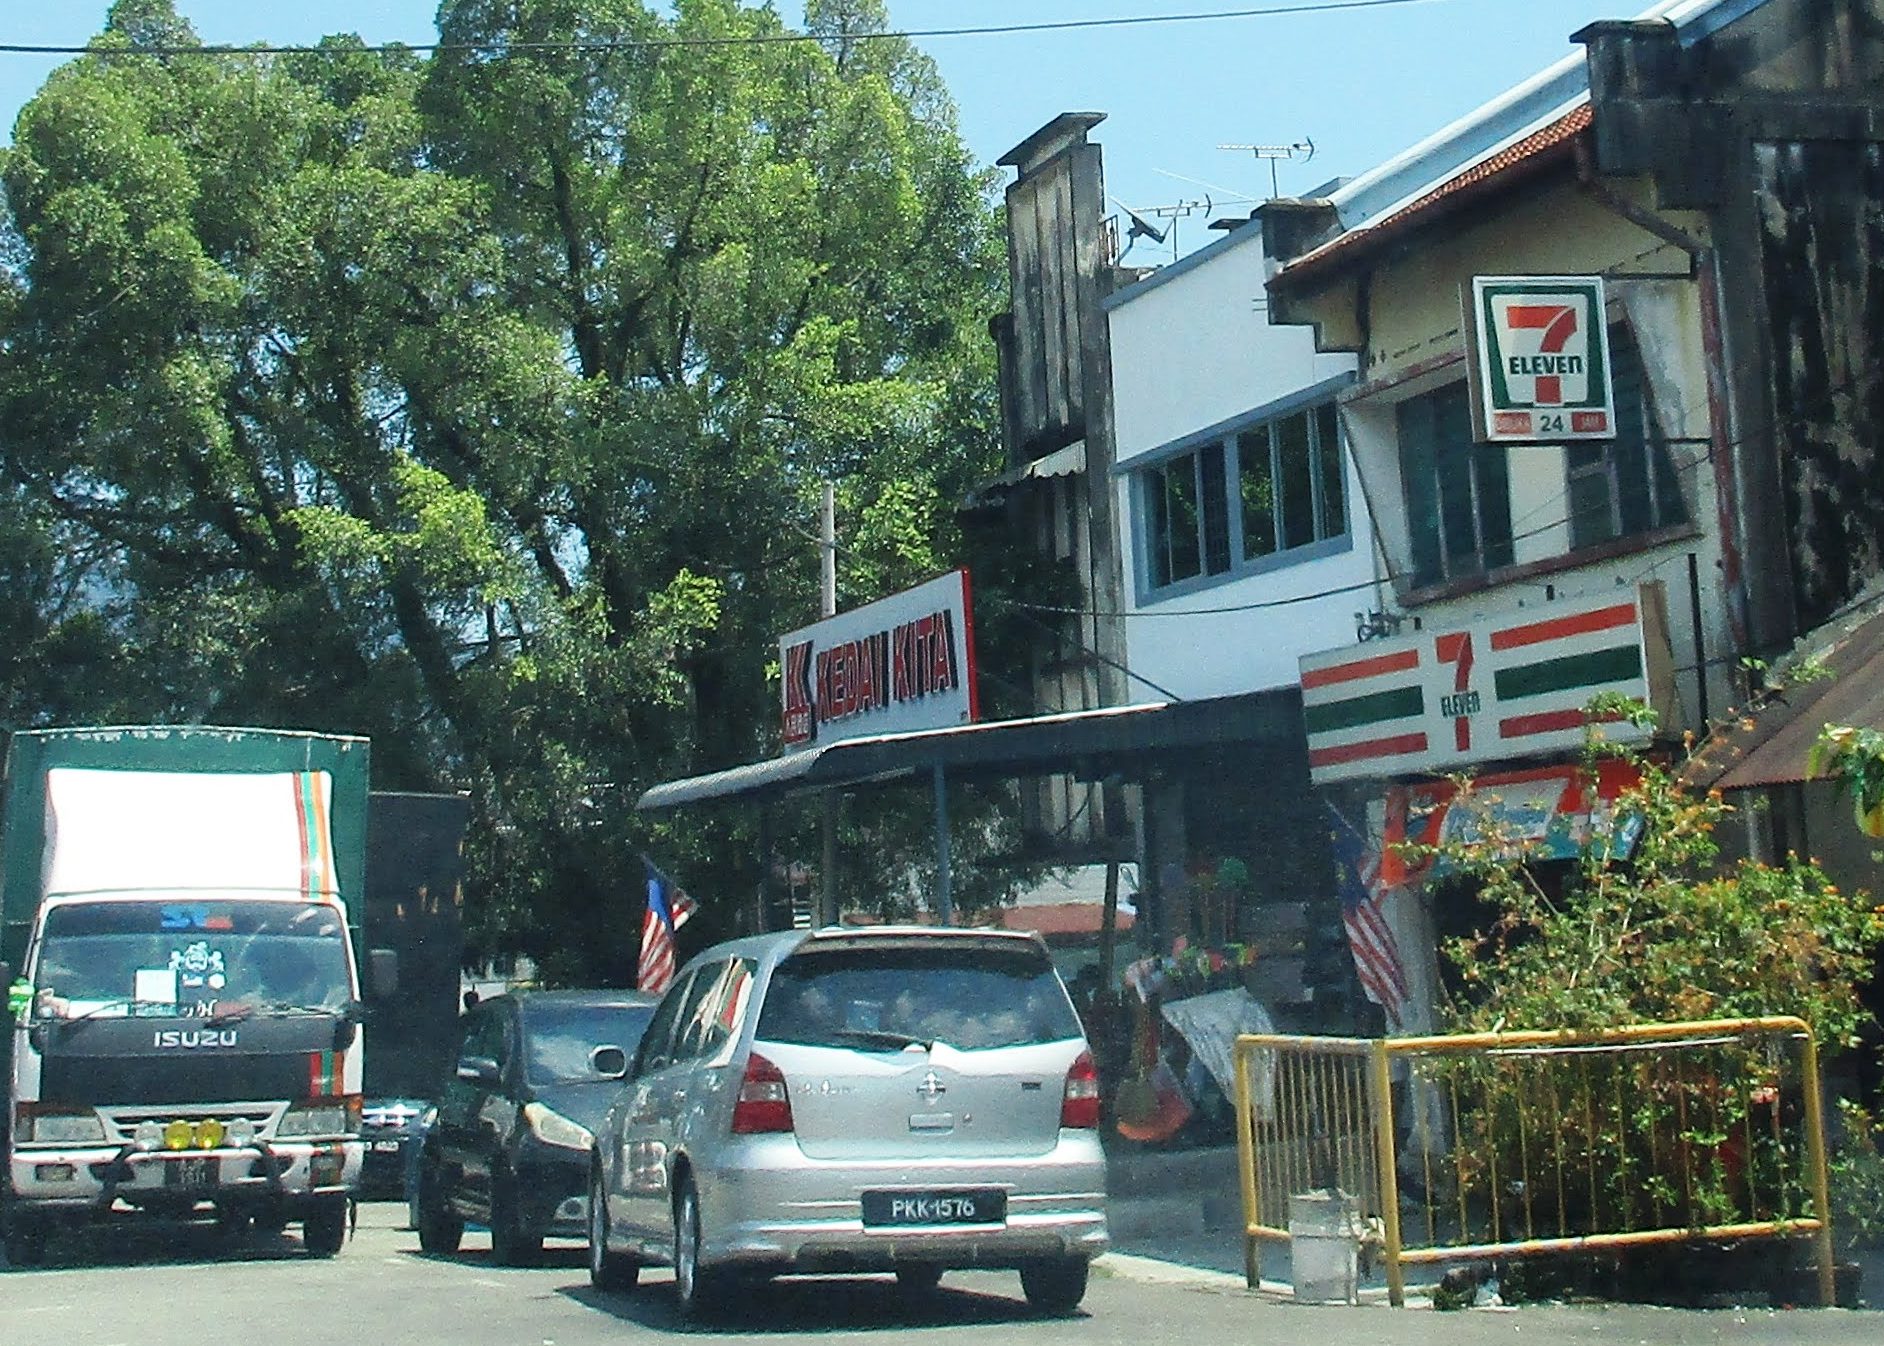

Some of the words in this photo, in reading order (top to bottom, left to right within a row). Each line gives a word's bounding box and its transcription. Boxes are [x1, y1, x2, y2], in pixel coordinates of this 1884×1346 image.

[1540, 415, 1564, 431] 24
[817, 631, 889, 723] KEDAI
[893, 609, 959, 702] KITA
[154, 1031, 237, 1048] ISUZU
